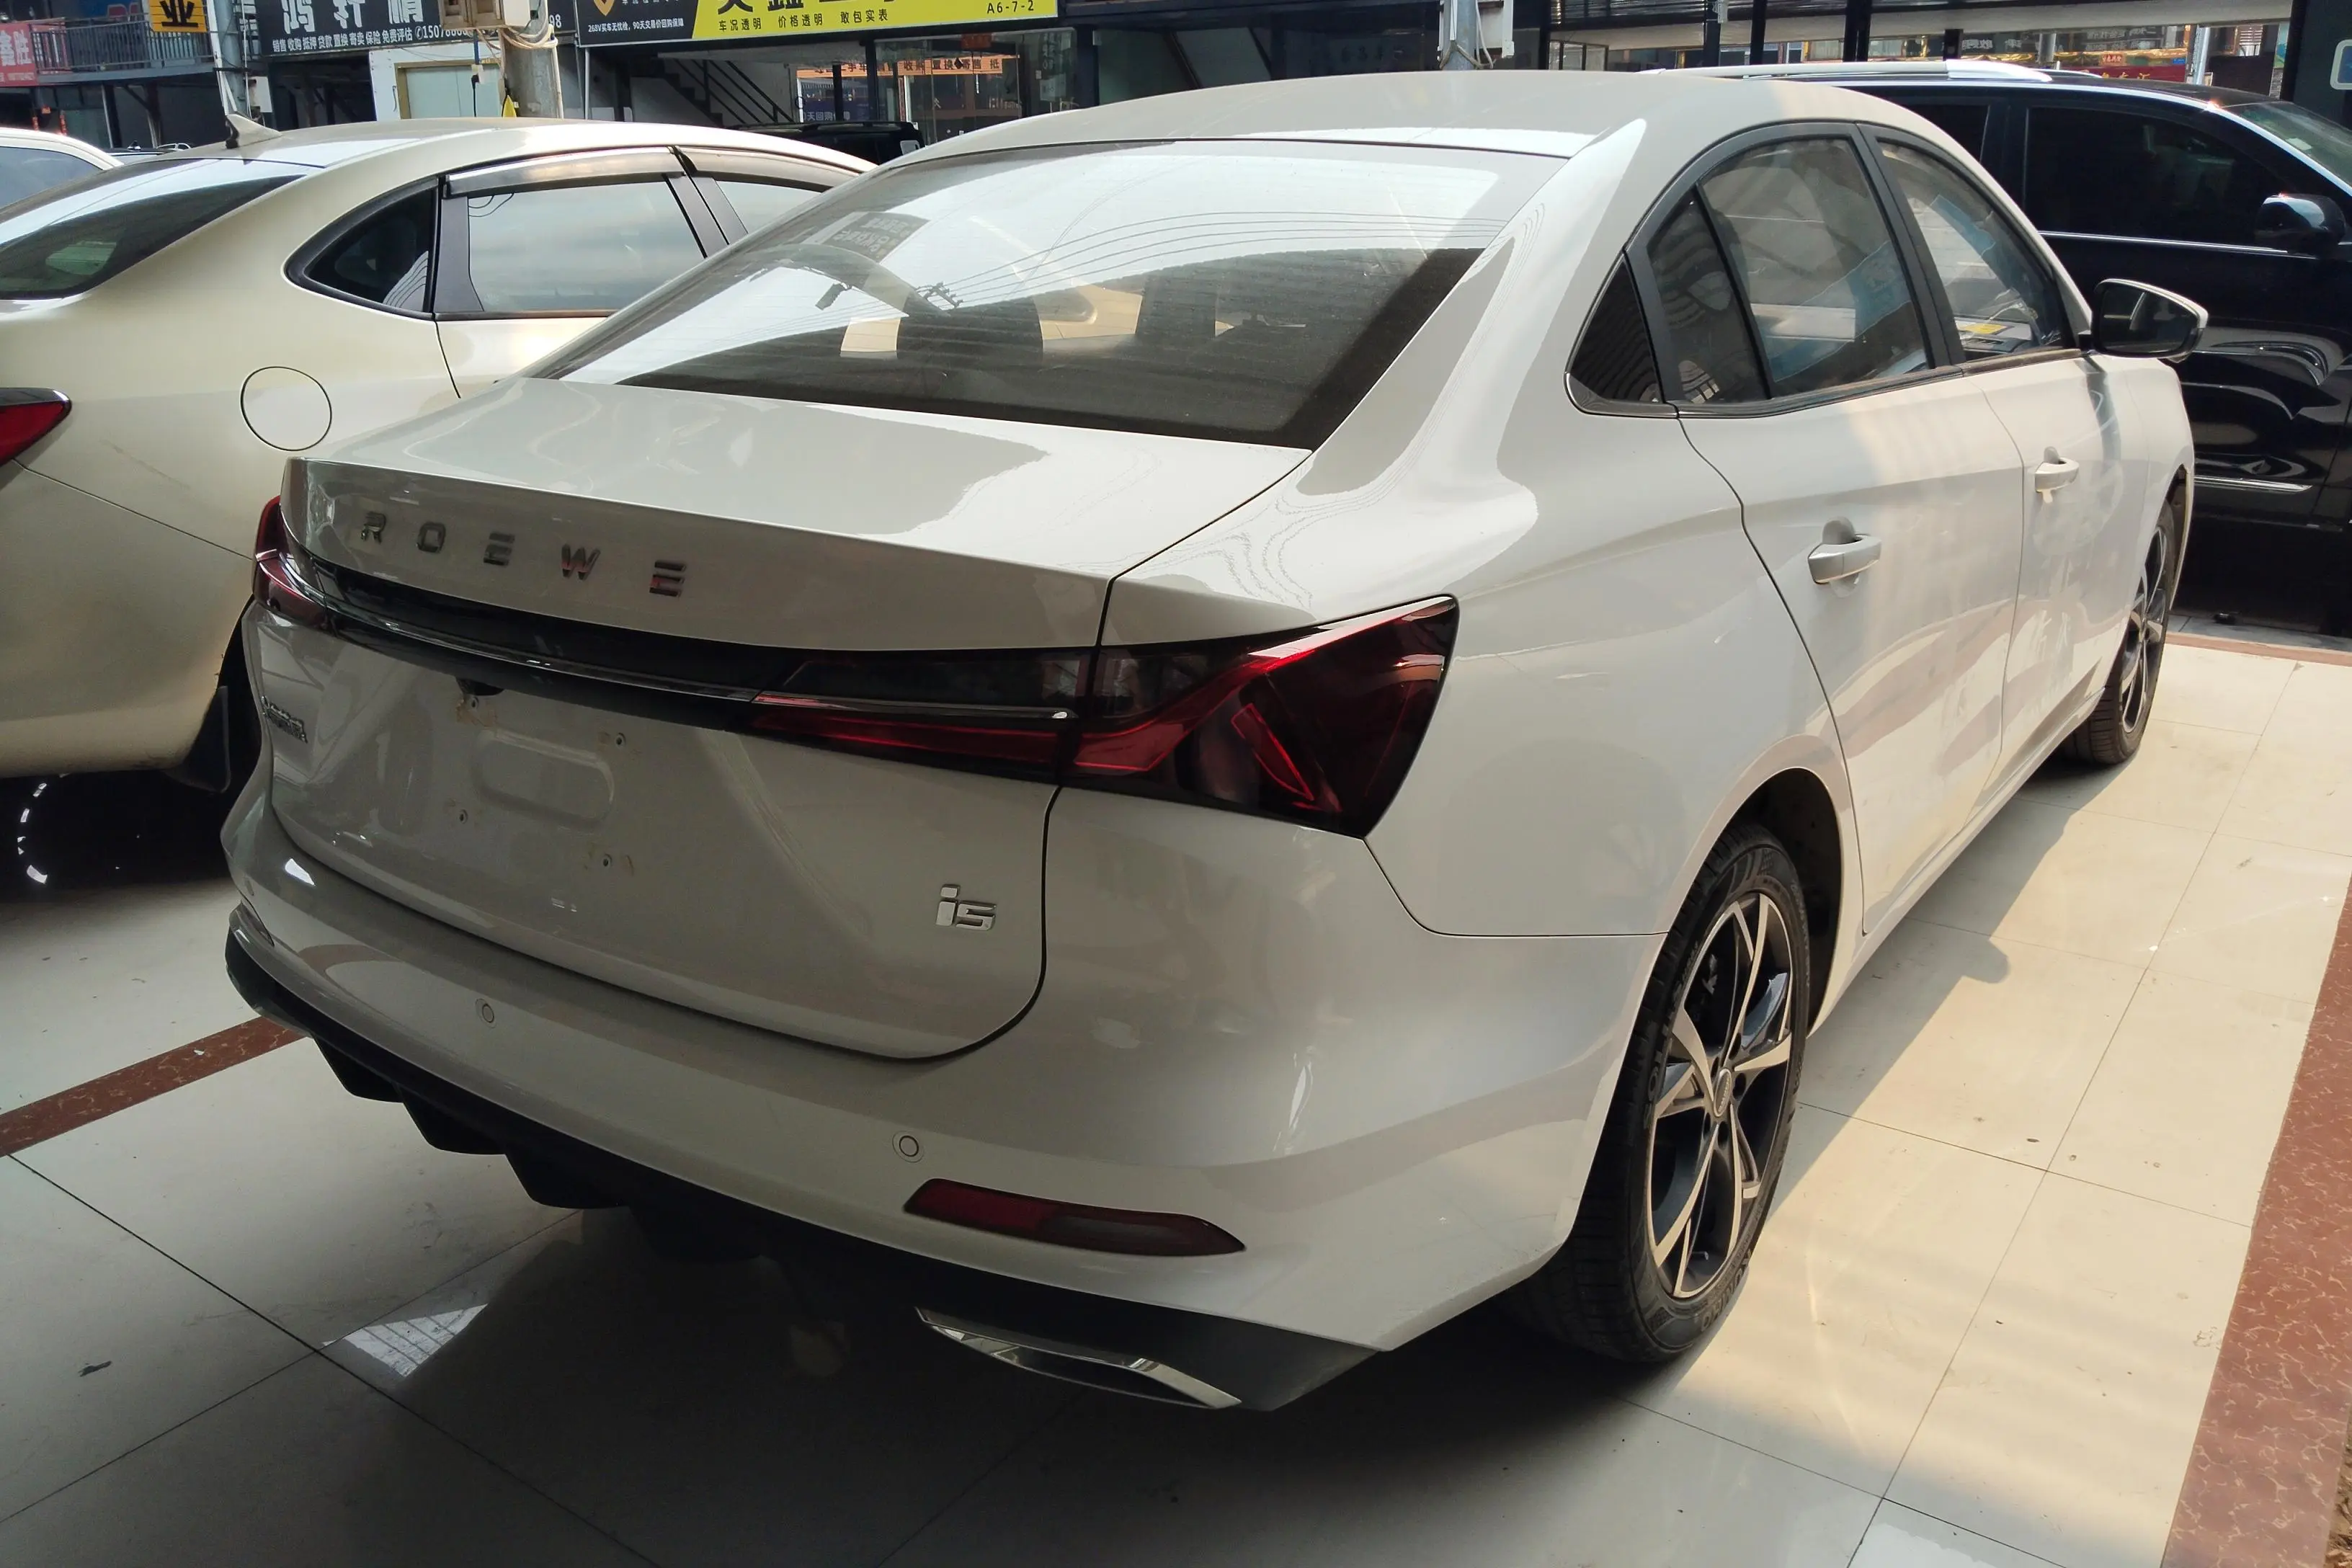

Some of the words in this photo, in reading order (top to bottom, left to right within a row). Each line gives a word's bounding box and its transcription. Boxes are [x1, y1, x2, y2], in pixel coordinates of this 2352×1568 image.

[986, 0, 1035, 14] A6-7-2
[719, 17, 762, 32] 车况透明
[778, 13, 824, 29] 价格透明
[840, 8, 888, 24] 敢包实表
[360, 510, 687, 598] ROEWE
